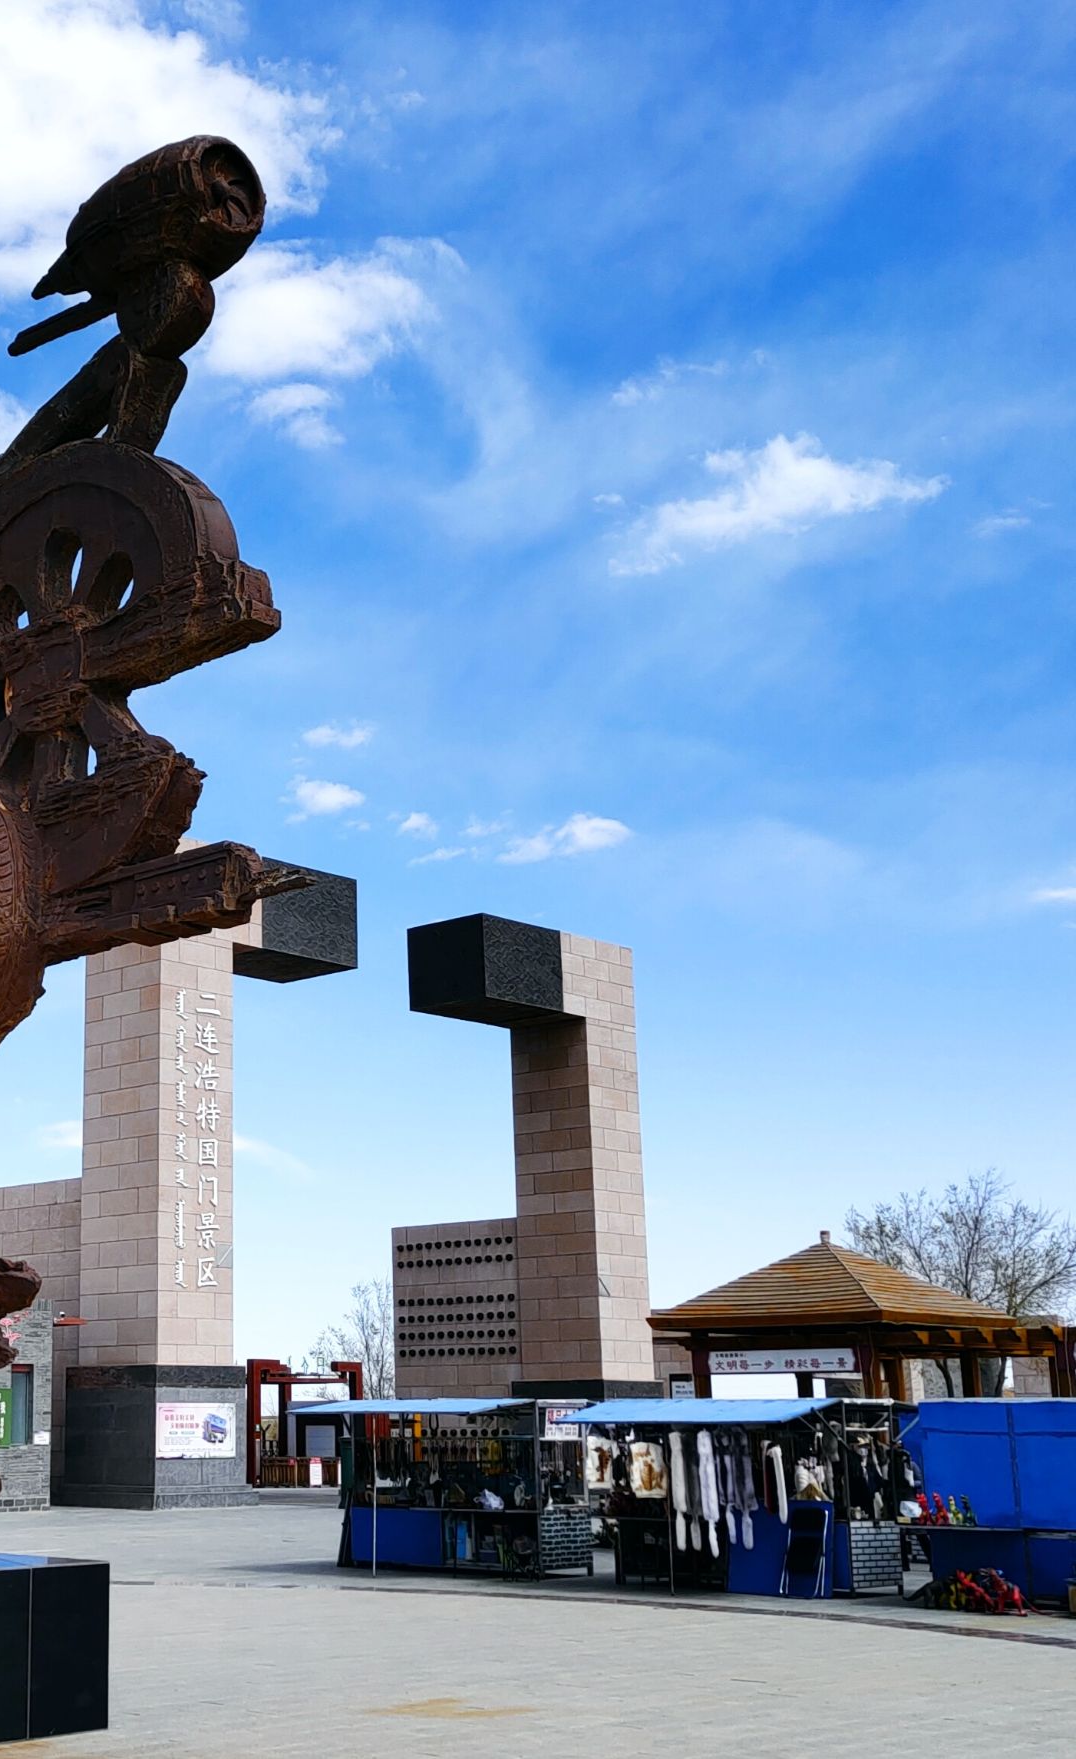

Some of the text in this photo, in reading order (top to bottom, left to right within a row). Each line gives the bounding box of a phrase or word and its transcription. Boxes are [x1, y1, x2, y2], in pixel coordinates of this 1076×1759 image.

[194, 994, 222, 1288] 二连浩特国门景区
[715, 1359, 775, 1371] 文明每一步
